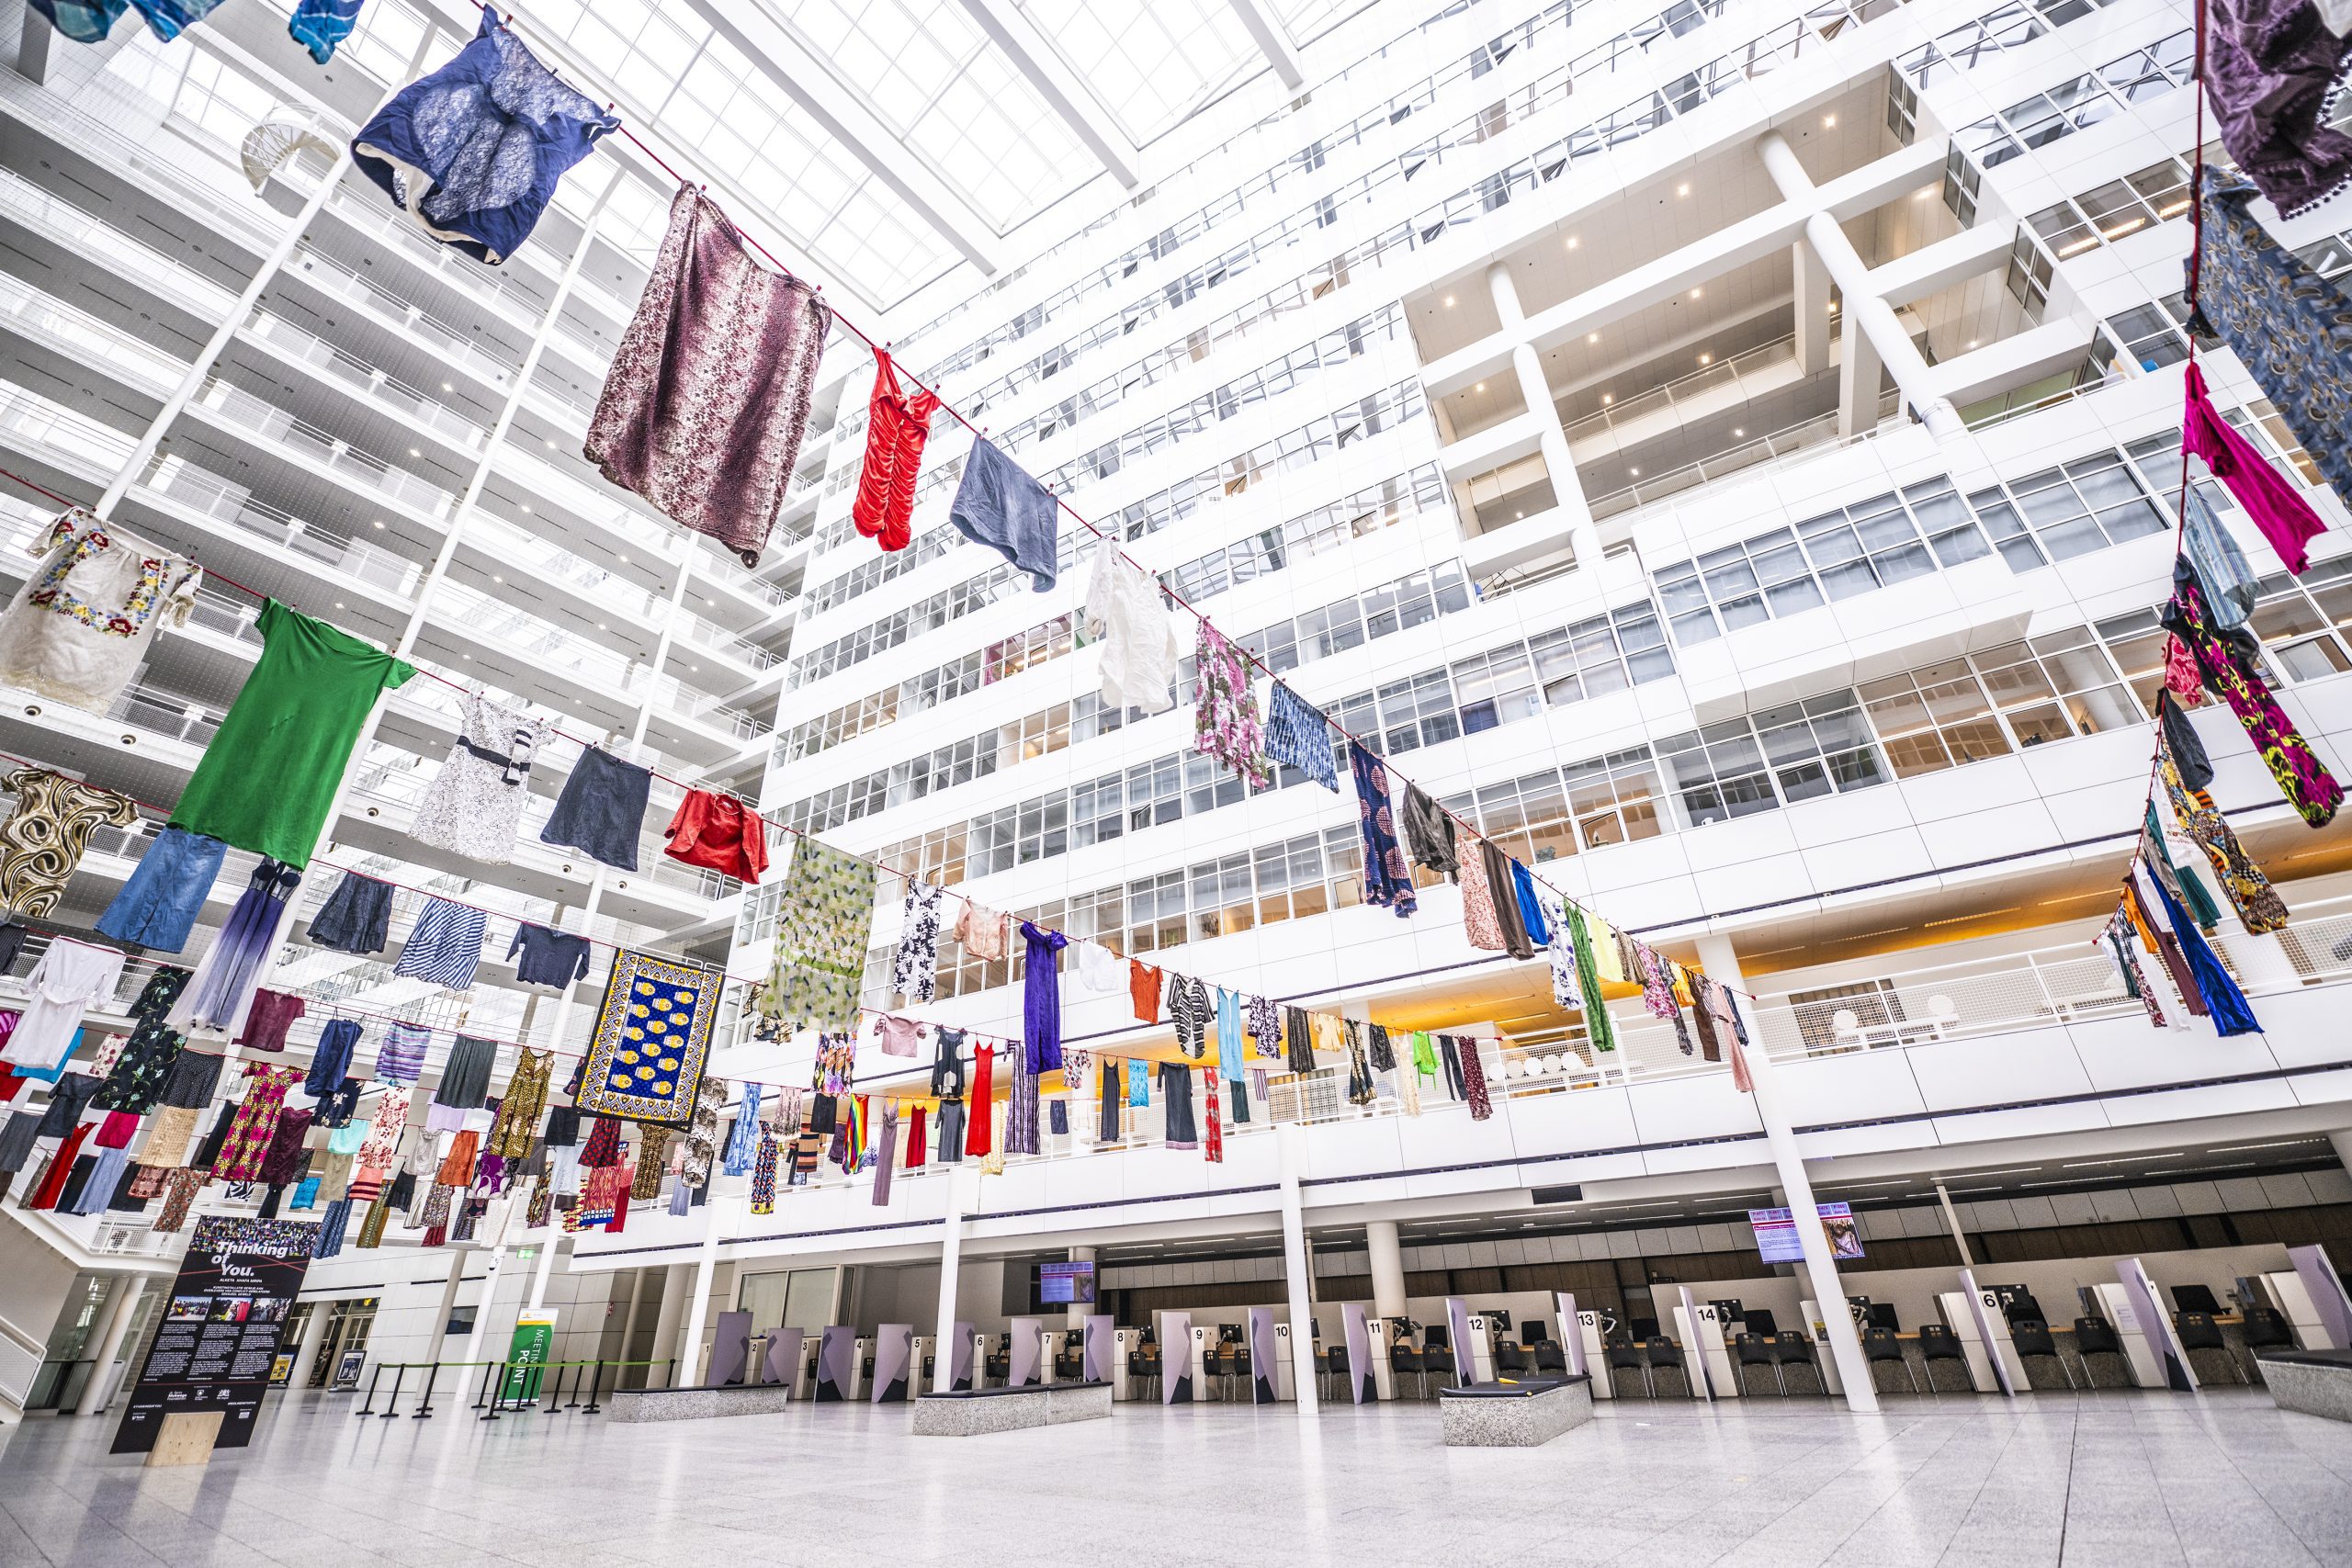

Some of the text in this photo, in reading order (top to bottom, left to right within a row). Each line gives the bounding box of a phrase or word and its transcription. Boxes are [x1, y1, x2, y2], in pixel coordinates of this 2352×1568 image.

[217, 1241, 288, 1258] Thinking
[210, 1253, 231, 1264] of
[220, 1263, 254, 1276] You.
[1980, 1294, 1996, 1308] 6
[1577, 1314, 1594, 1326] 13
[1697, 1309, 1716, 1321] 14
[1369, 1323, 1381, 1333] 11
[1468, 1319, 1484, 1330] 12
[1117, 1332, 1124, 1342] 8
[1195, 1329, 1203, 1340] 9
[1275, 1326, 1288, 1337] 10
[856, 1341, 862, 1349] 4
[915, 1338, 921, 1348] 5
[978, 1337, 983, 1346] 6
[1045, 1335, 1051, 1344] 7
[528, 1329, 545, 1371] MEETIN
[706, 1345, 710, 1353] 1
[752, 1344, 757, 1352] 2
[802, 1342, 808, 1351] 3
